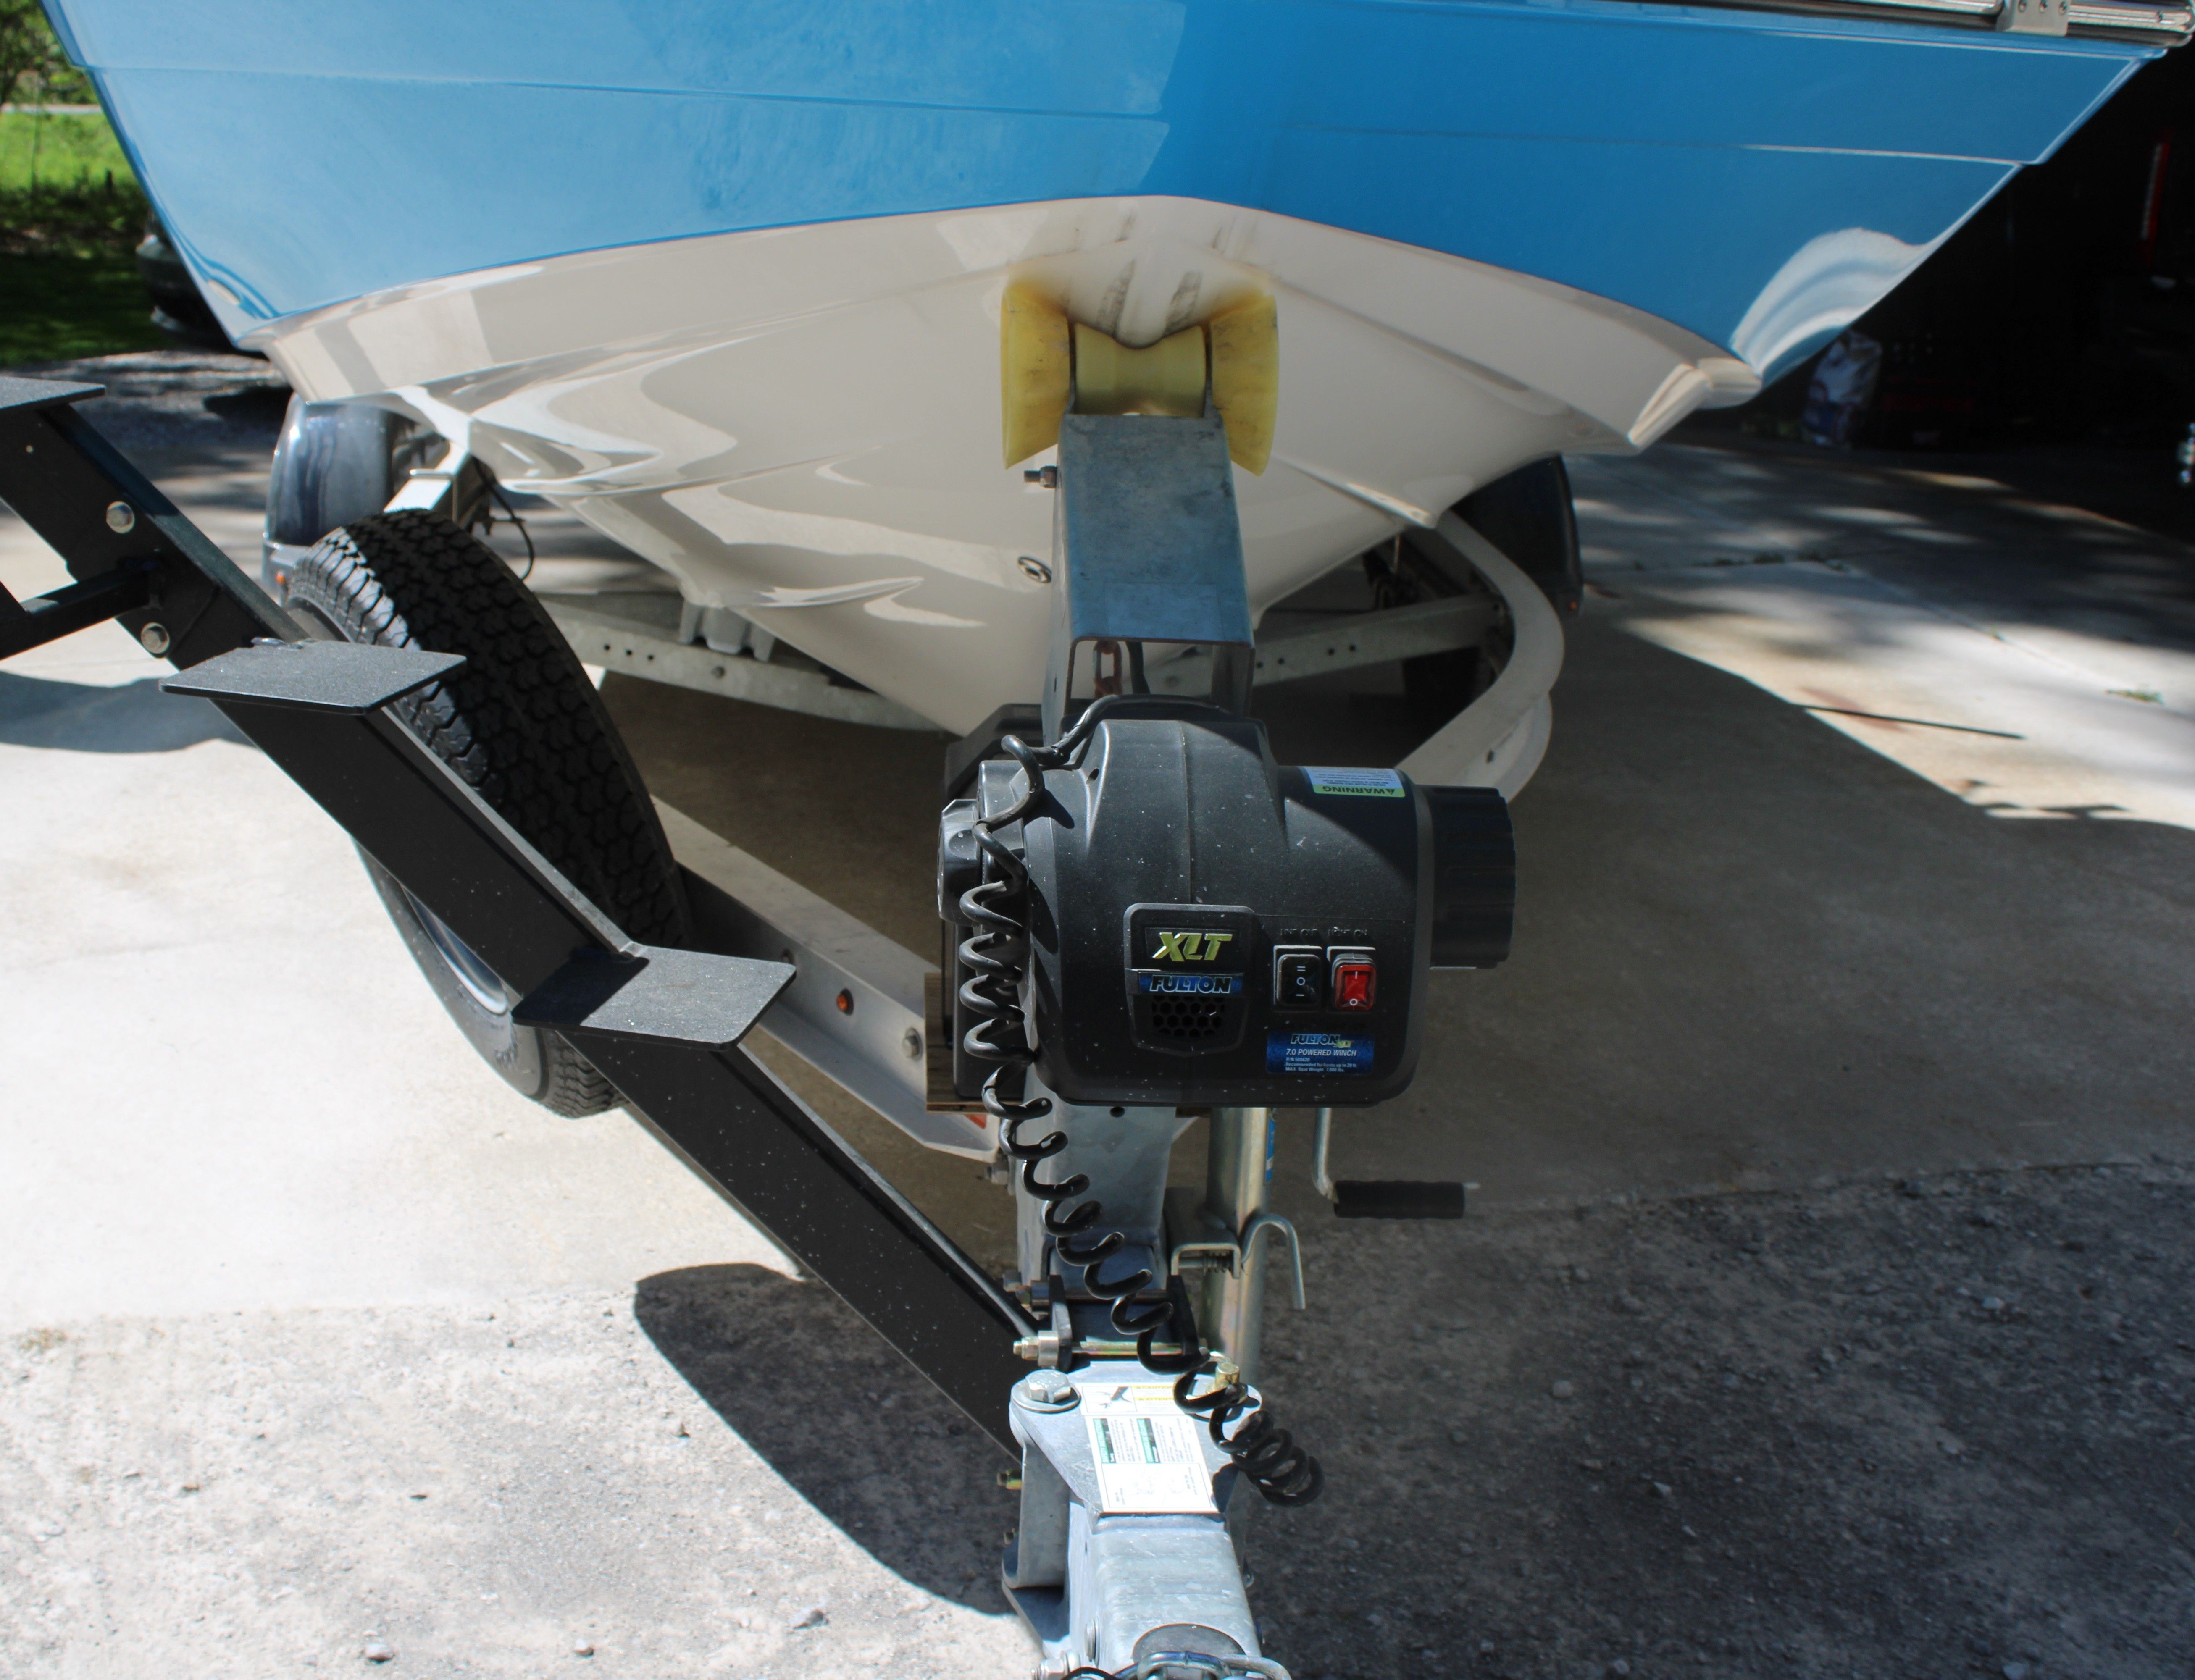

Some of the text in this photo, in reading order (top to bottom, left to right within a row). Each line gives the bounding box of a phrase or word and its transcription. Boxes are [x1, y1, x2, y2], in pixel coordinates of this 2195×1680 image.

[1322, 786, 1385, 795] WARNING
[1151, 932, 1233, 962] XLT
[1149, 974, 1233, 994] FULTON
[1290, 1033, 1341, 1045] FULTON
